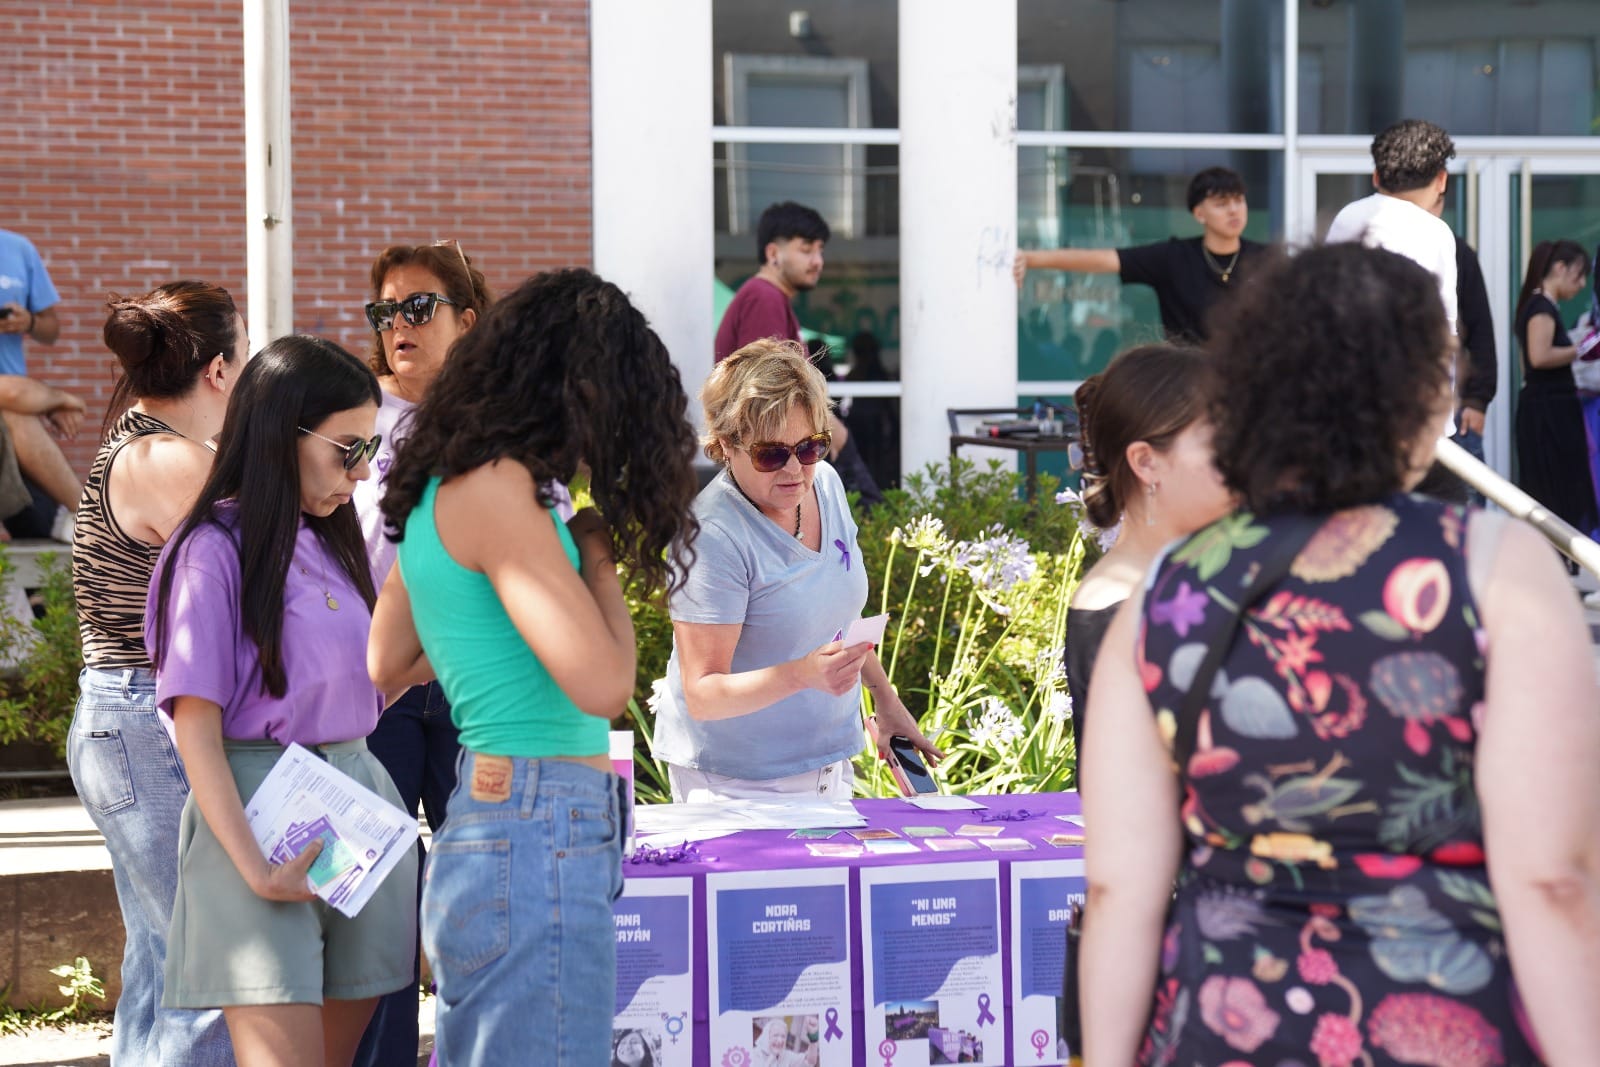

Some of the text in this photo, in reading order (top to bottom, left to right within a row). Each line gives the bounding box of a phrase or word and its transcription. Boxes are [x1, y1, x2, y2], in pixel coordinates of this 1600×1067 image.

[765, 904, 798, 917] NORA
[911, 897, 956, 911] "NI UNA
[752, 917, 811, 933] CORTIÑAS
[911, 912, 956, 927] MENOS"
[615, 926, 651, 943] AYÁN
